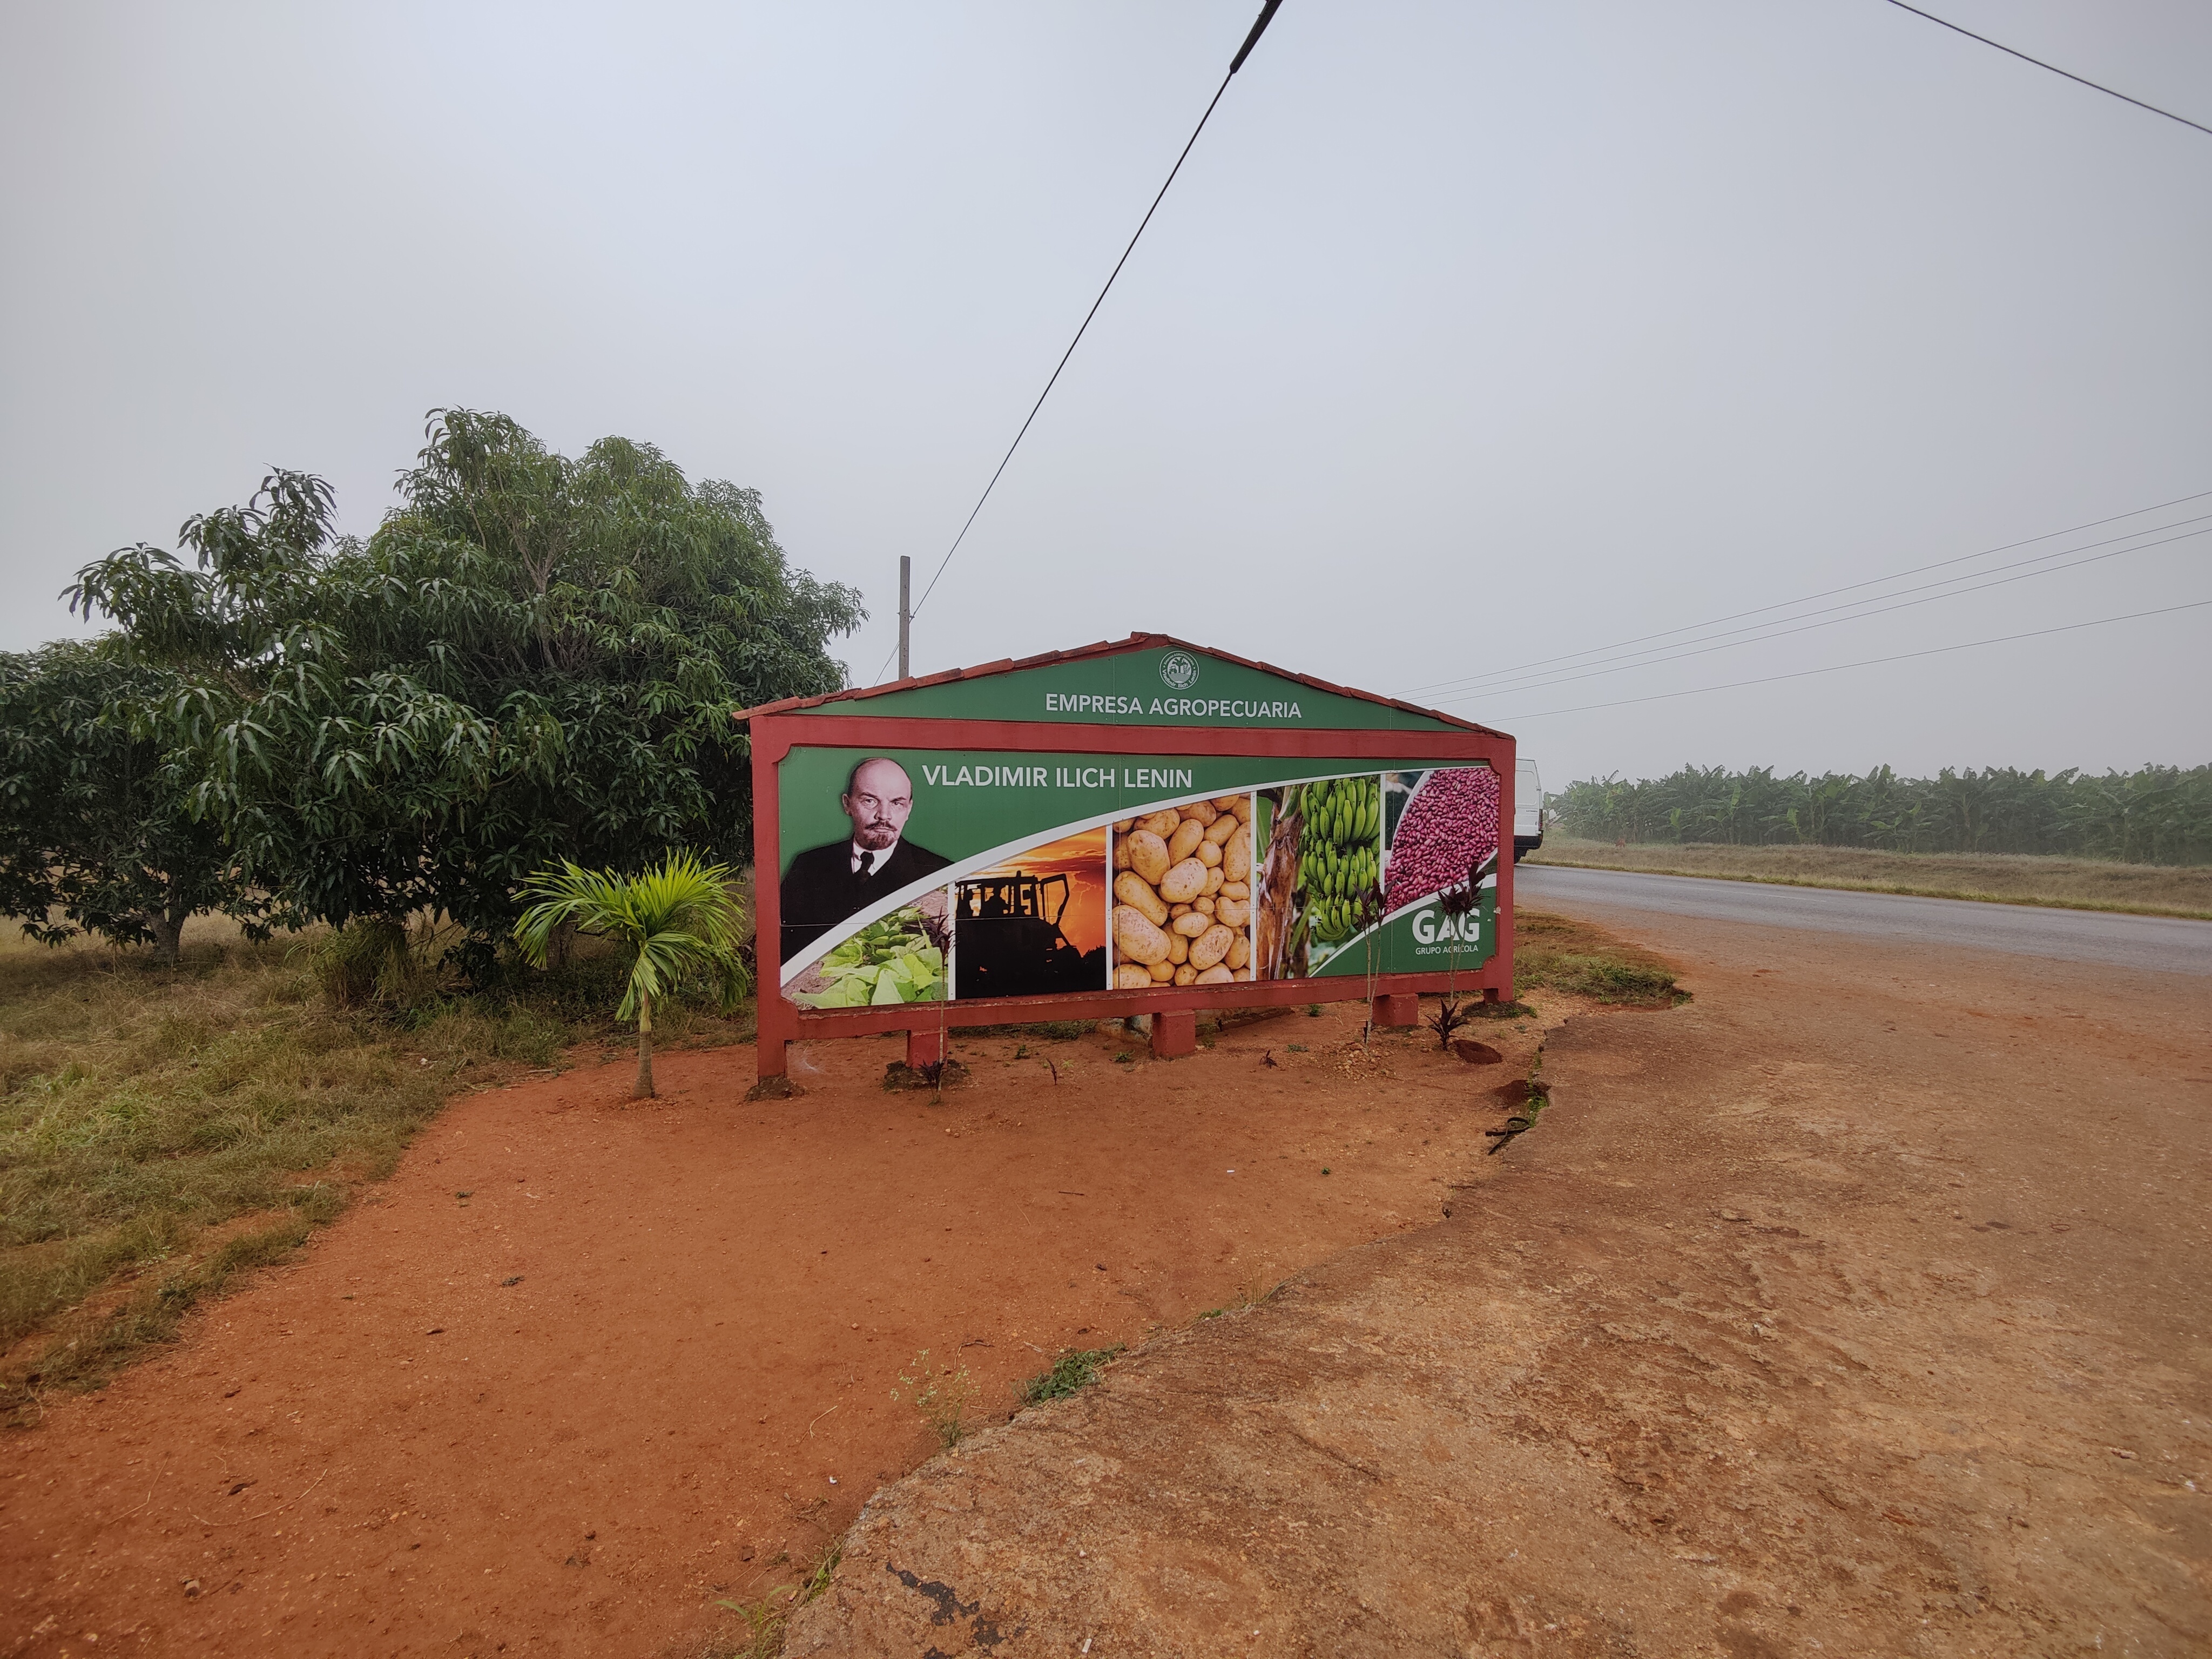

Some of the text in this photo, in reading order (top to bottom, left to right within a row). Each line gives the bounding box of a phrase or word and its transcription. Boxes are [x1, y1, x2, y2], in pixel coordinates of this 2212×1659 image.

[1162, 669, 1176, 687] Vladimir
[1189, 670, 1197, 684] Lenin
[1046, 693, 1301, 718] EMPRESA AGROPECUARIA
[922, 765, 1192, 788] VLADIMIR ILICH LENIN
[1412, 908, 1480, 944] GAG
[1415, 947, 1441, 955] GRUPO
